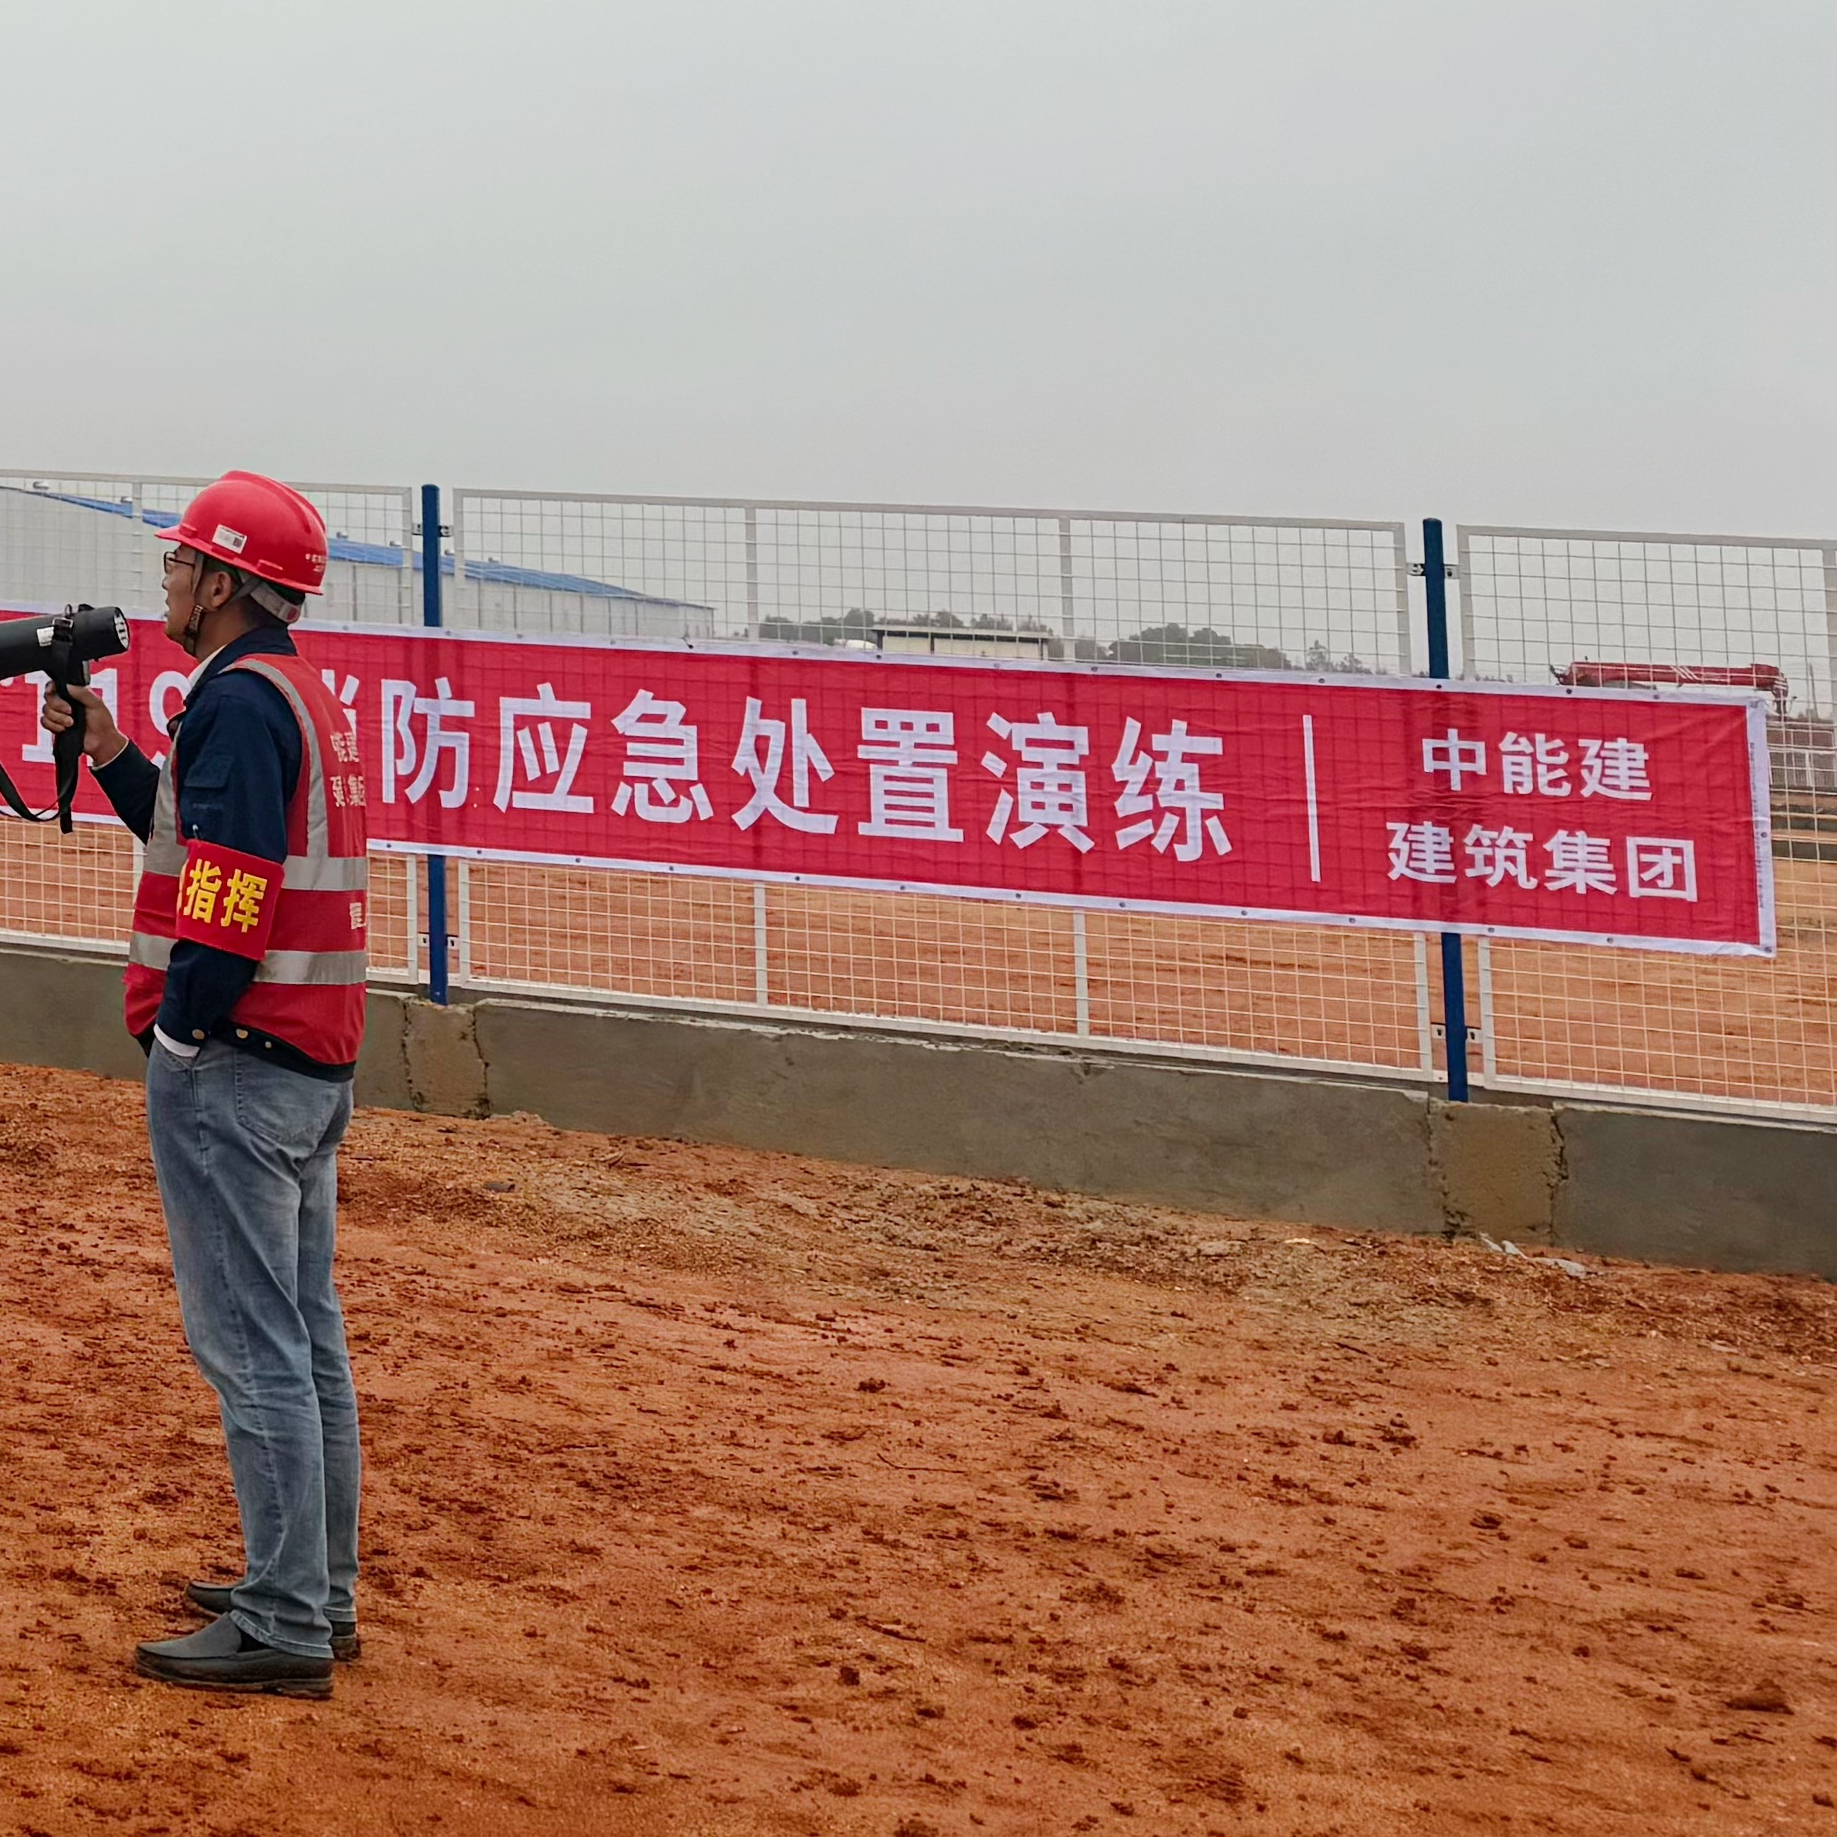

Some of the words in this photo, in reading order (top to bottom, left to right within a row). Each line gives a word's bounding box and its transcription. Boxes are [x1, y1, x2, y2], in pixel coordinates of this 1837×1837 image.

[1421, 728, 1653, 801] 中能建
[1385, 821, 1698, 902] 建筑集团
